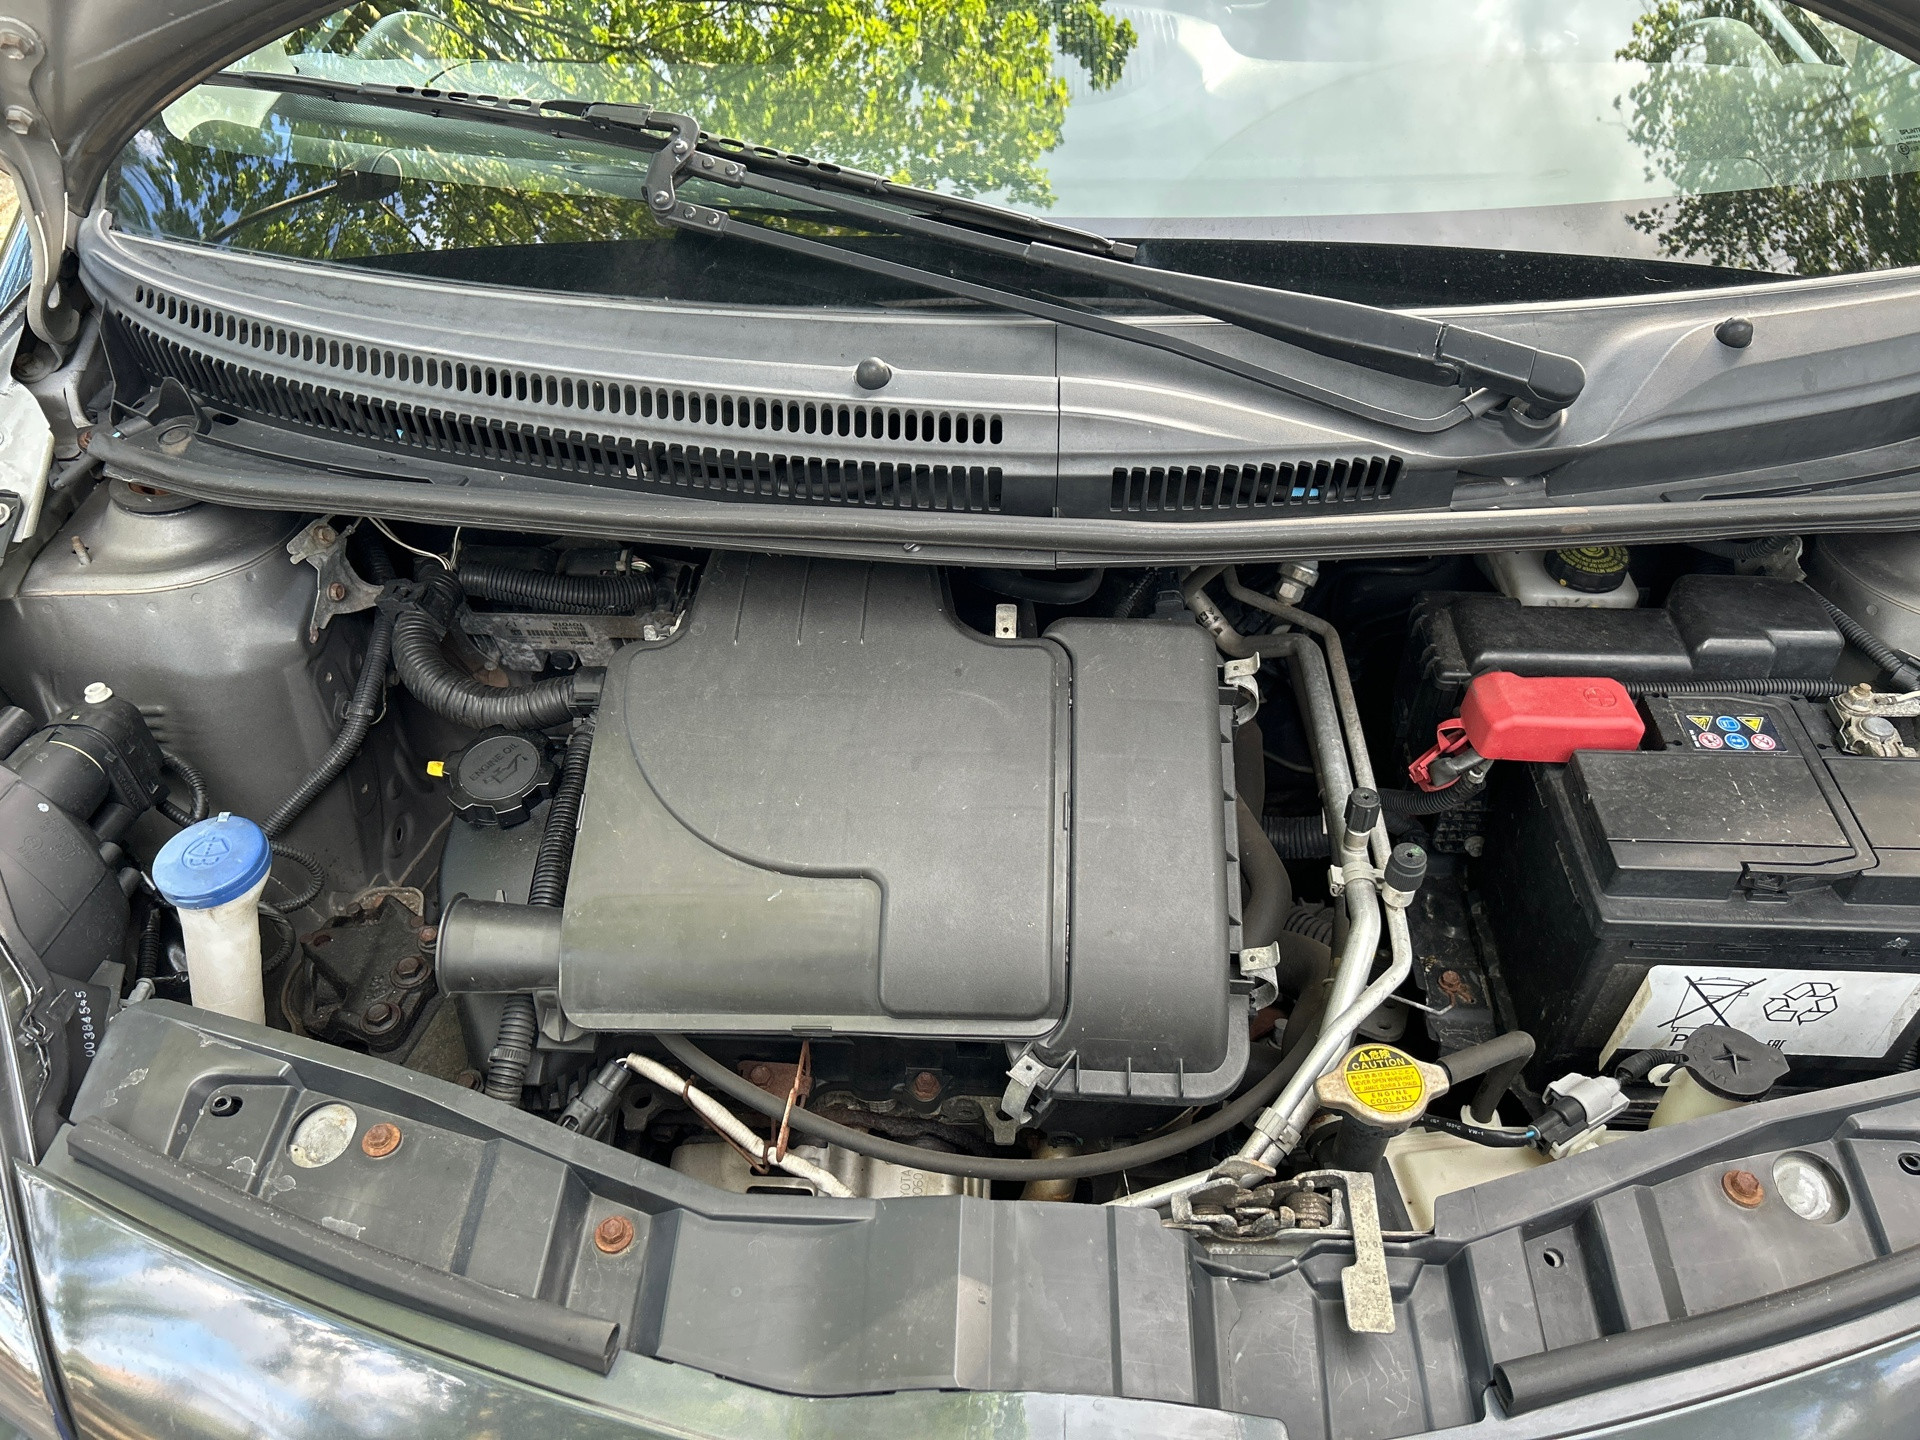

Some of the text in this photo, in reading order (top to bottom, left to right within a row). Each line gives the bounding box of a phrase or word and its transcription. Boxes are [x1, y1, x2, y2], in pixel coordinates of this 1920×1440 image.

[469, 743, 519, 781] ENGINE OIL
[1369, 1049, 1391, 1060] 危険
[1352, 1058, 1405, 1070] CAUTION
[1370, 1095, 1412, 1104] COOLANT
[1371, 1089, 1408, 1098] ENGINE
[900, 1169, 912, 1196] YOTA
[912, 1172, 924, 1196] 060
